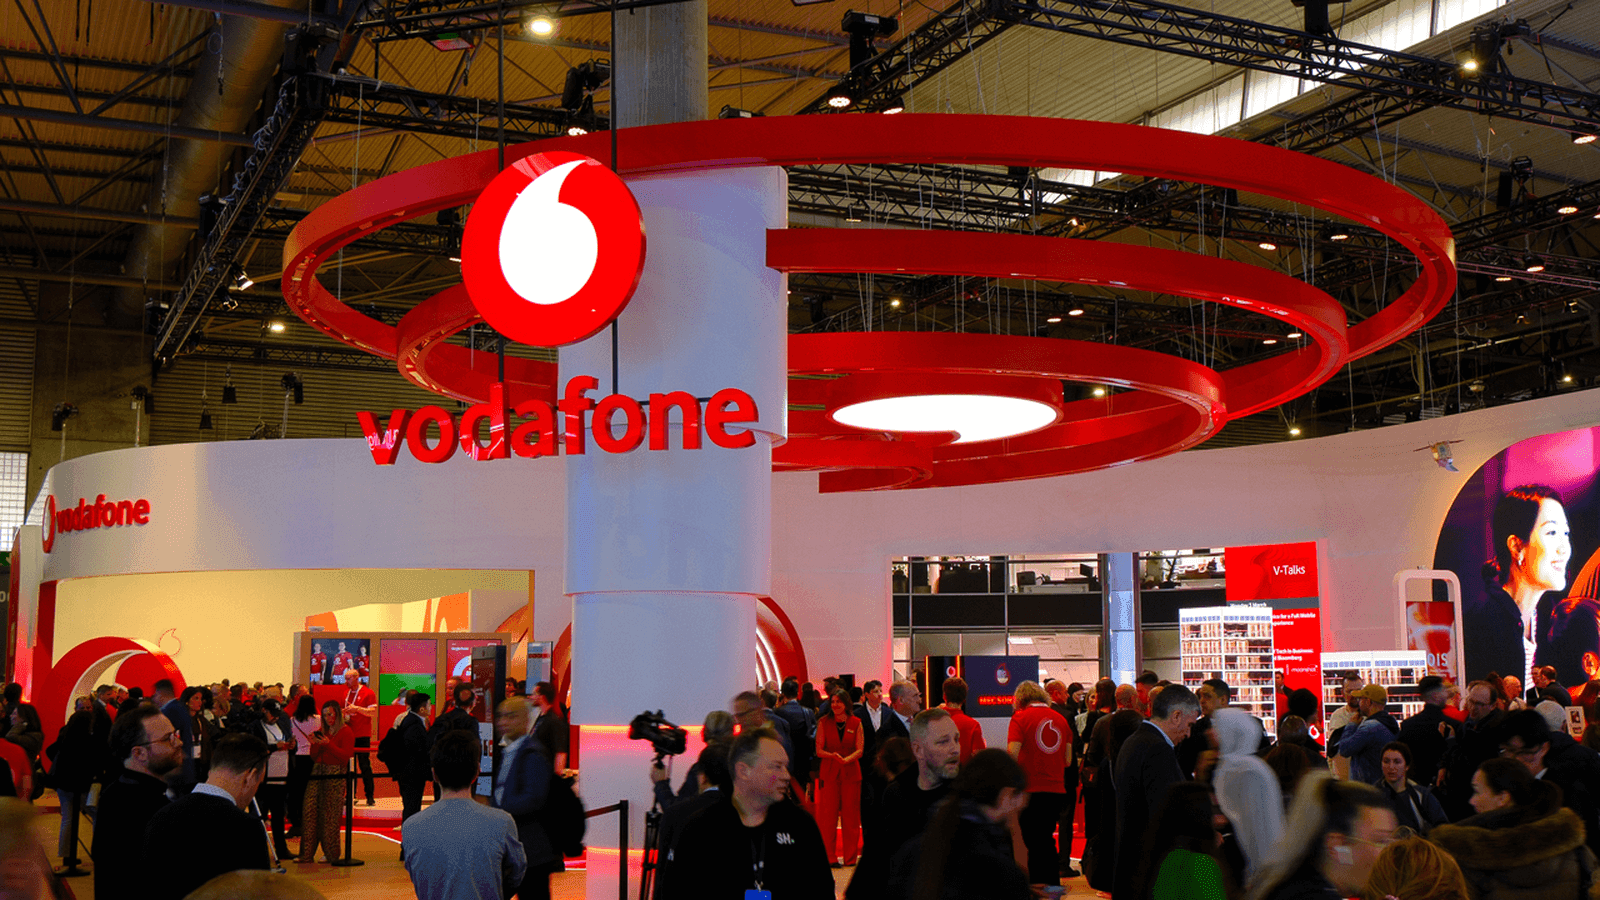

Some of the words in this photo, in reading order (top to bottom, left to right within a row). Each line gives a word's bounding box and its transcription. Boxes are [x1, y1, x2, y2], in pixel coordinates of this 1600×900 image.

[356, 374, 760, 466] vodafone
[56, 494, 151, 533] vodafone
[1273, 564, 1306, 575] V-Talks
[1427, 652, 1448, 666] OIS
